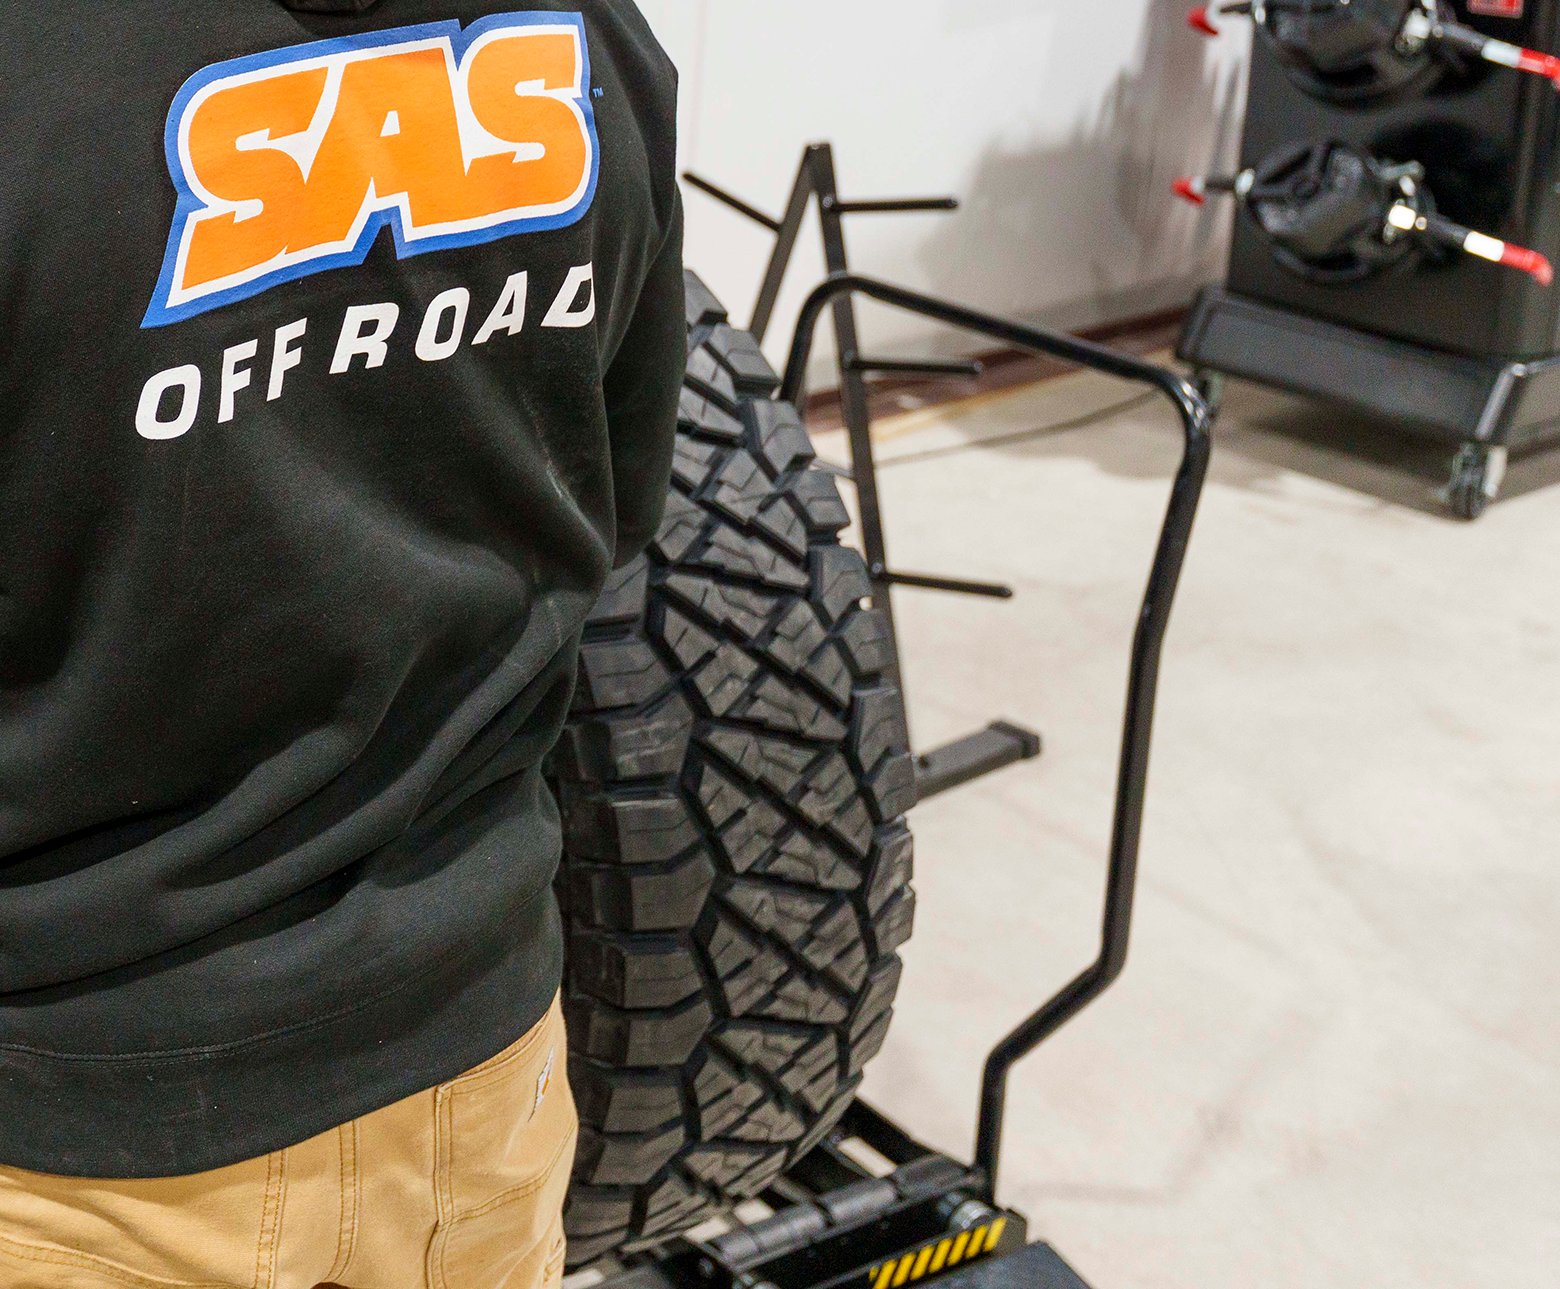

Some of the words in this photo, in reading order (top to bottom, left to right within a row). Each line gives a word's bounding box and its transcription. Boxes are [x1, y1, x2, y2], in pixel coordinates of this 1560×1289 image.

[162, 21, 596, 311] SAS
[135, 318, 307, 440] OFF
[329, 261, 595, 375] ROAD
